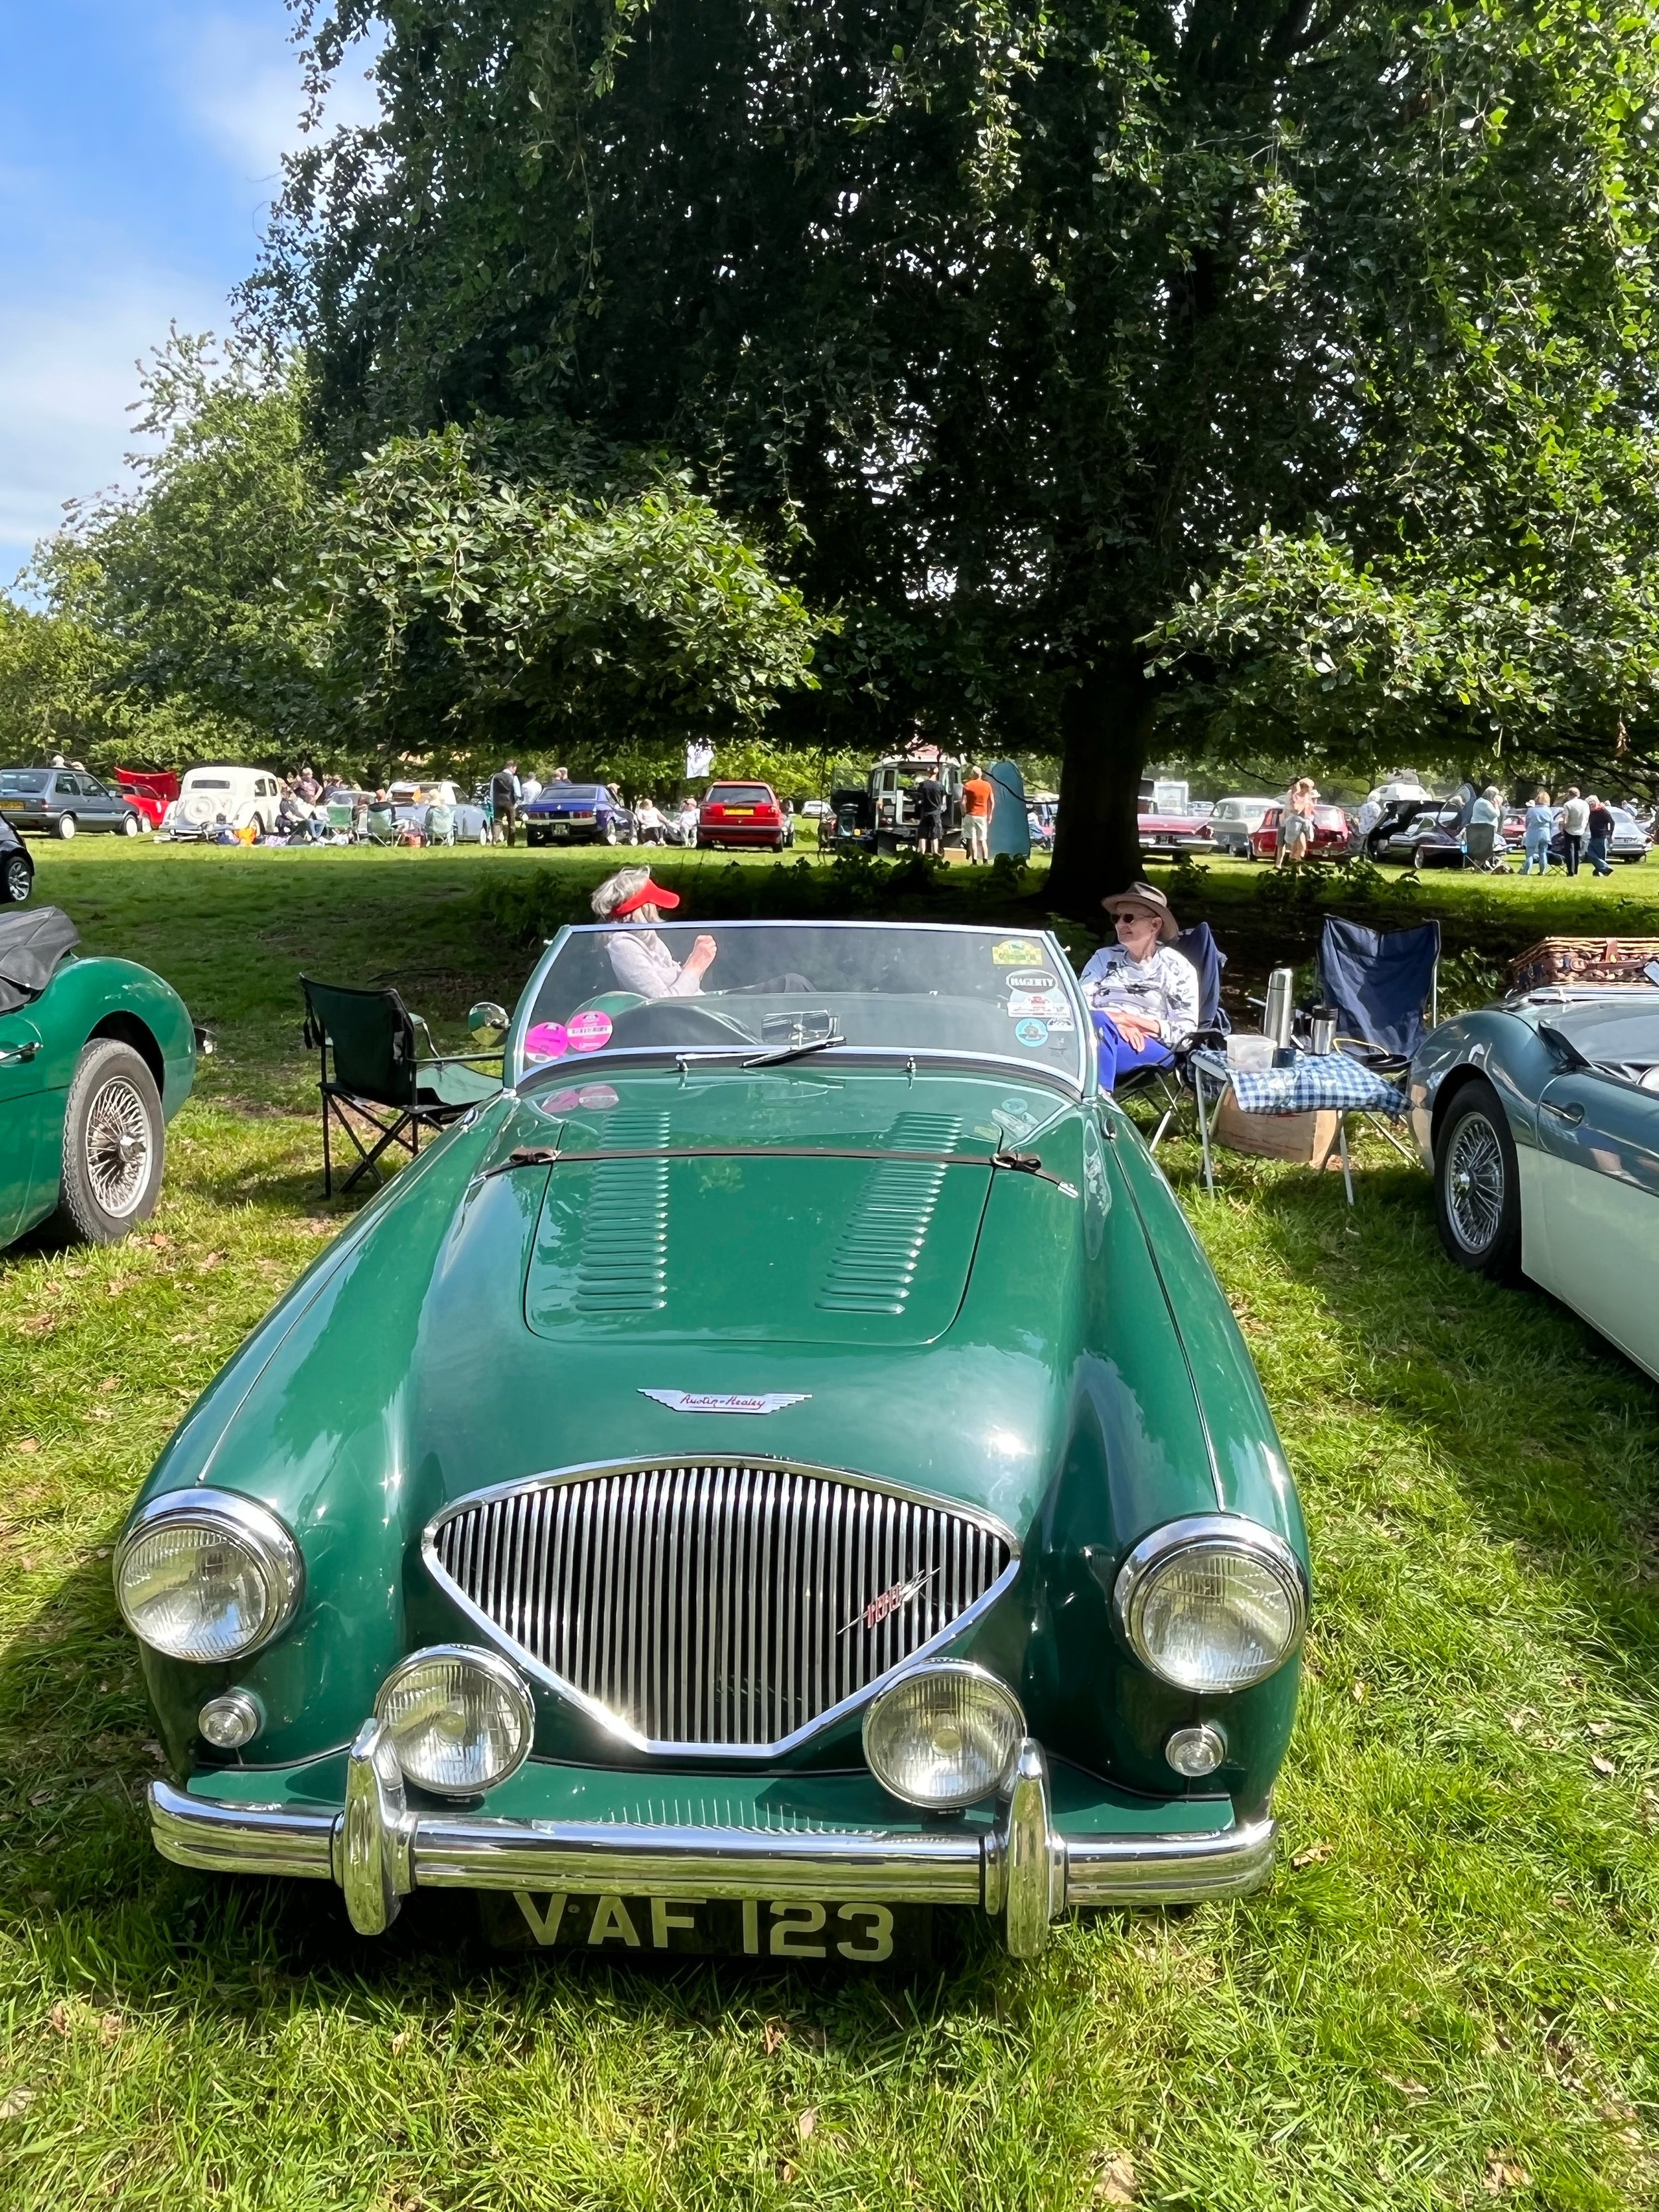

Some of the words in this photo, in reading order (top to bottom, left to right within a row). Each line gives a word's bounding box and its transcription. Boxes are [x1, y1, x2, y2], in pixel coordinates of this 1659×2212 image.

[1010, 978, 1054, 987] HAGERTY
[680, 1394, 765, 1410] Austin-Healey
[513, 1891, 707, 1948] VAF
[742, 1899, 894, 1962] 123
